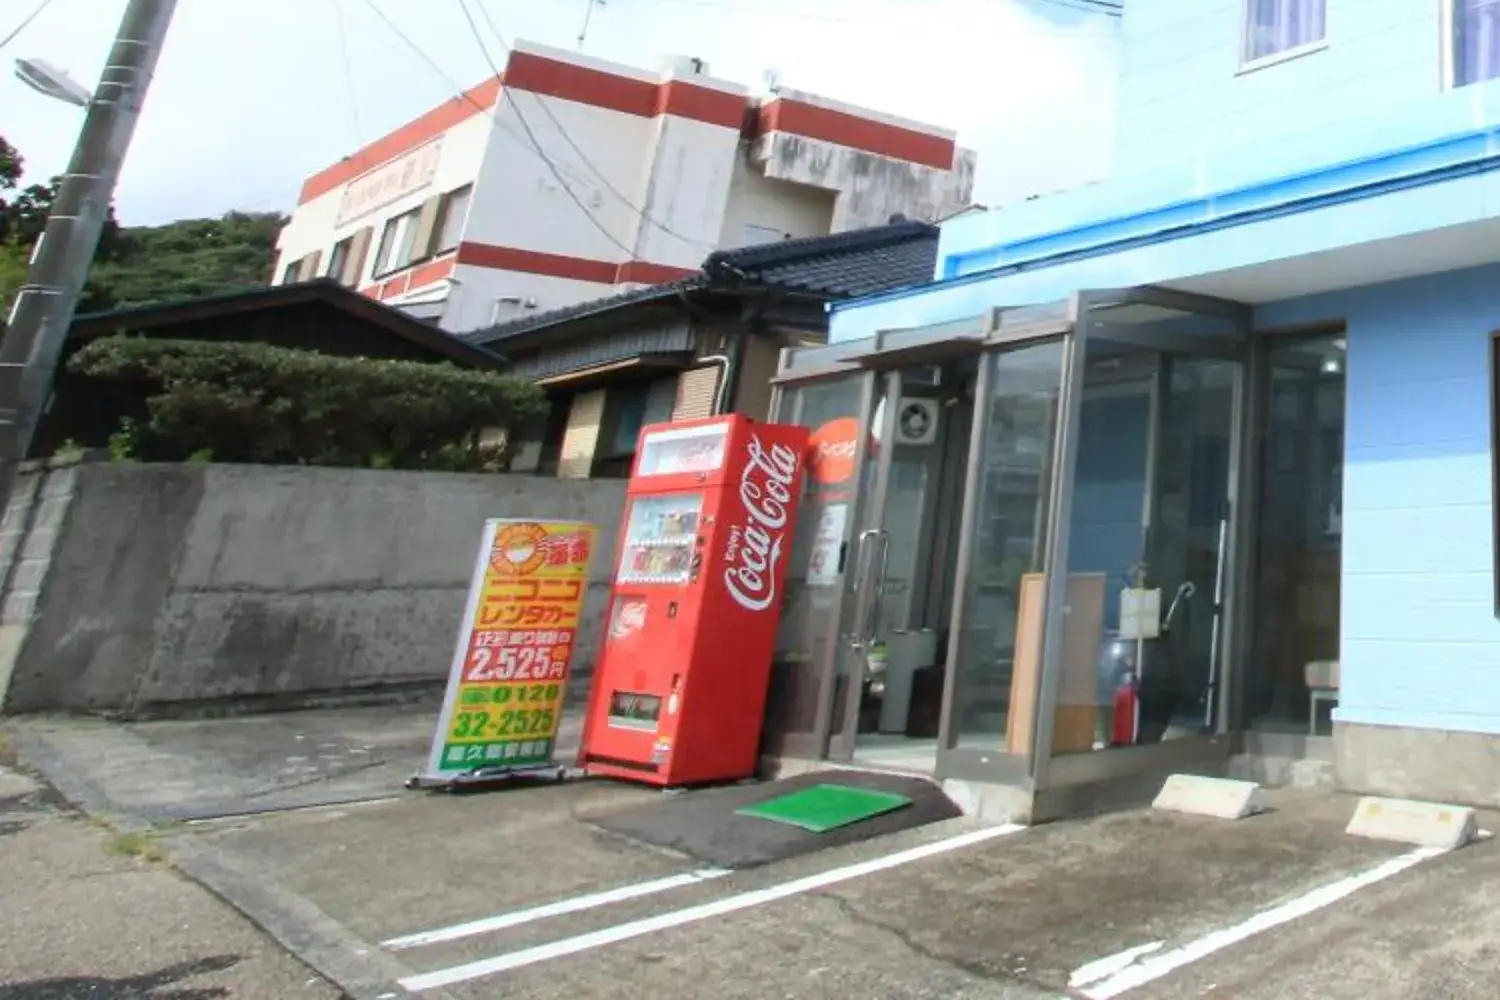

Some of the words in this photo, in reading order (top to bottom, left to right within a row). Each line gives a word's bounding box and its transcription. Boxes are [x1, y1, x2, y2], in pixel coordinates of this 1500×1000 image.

[723, 432, 798, 611] Coca-Cola
[487, 578, 581, 602] ニコニコ
[480, 604, 577, 624] レンタカー
[490, 684, 558, 704] 0120
[452, 708, 553, 738] 32-2525
